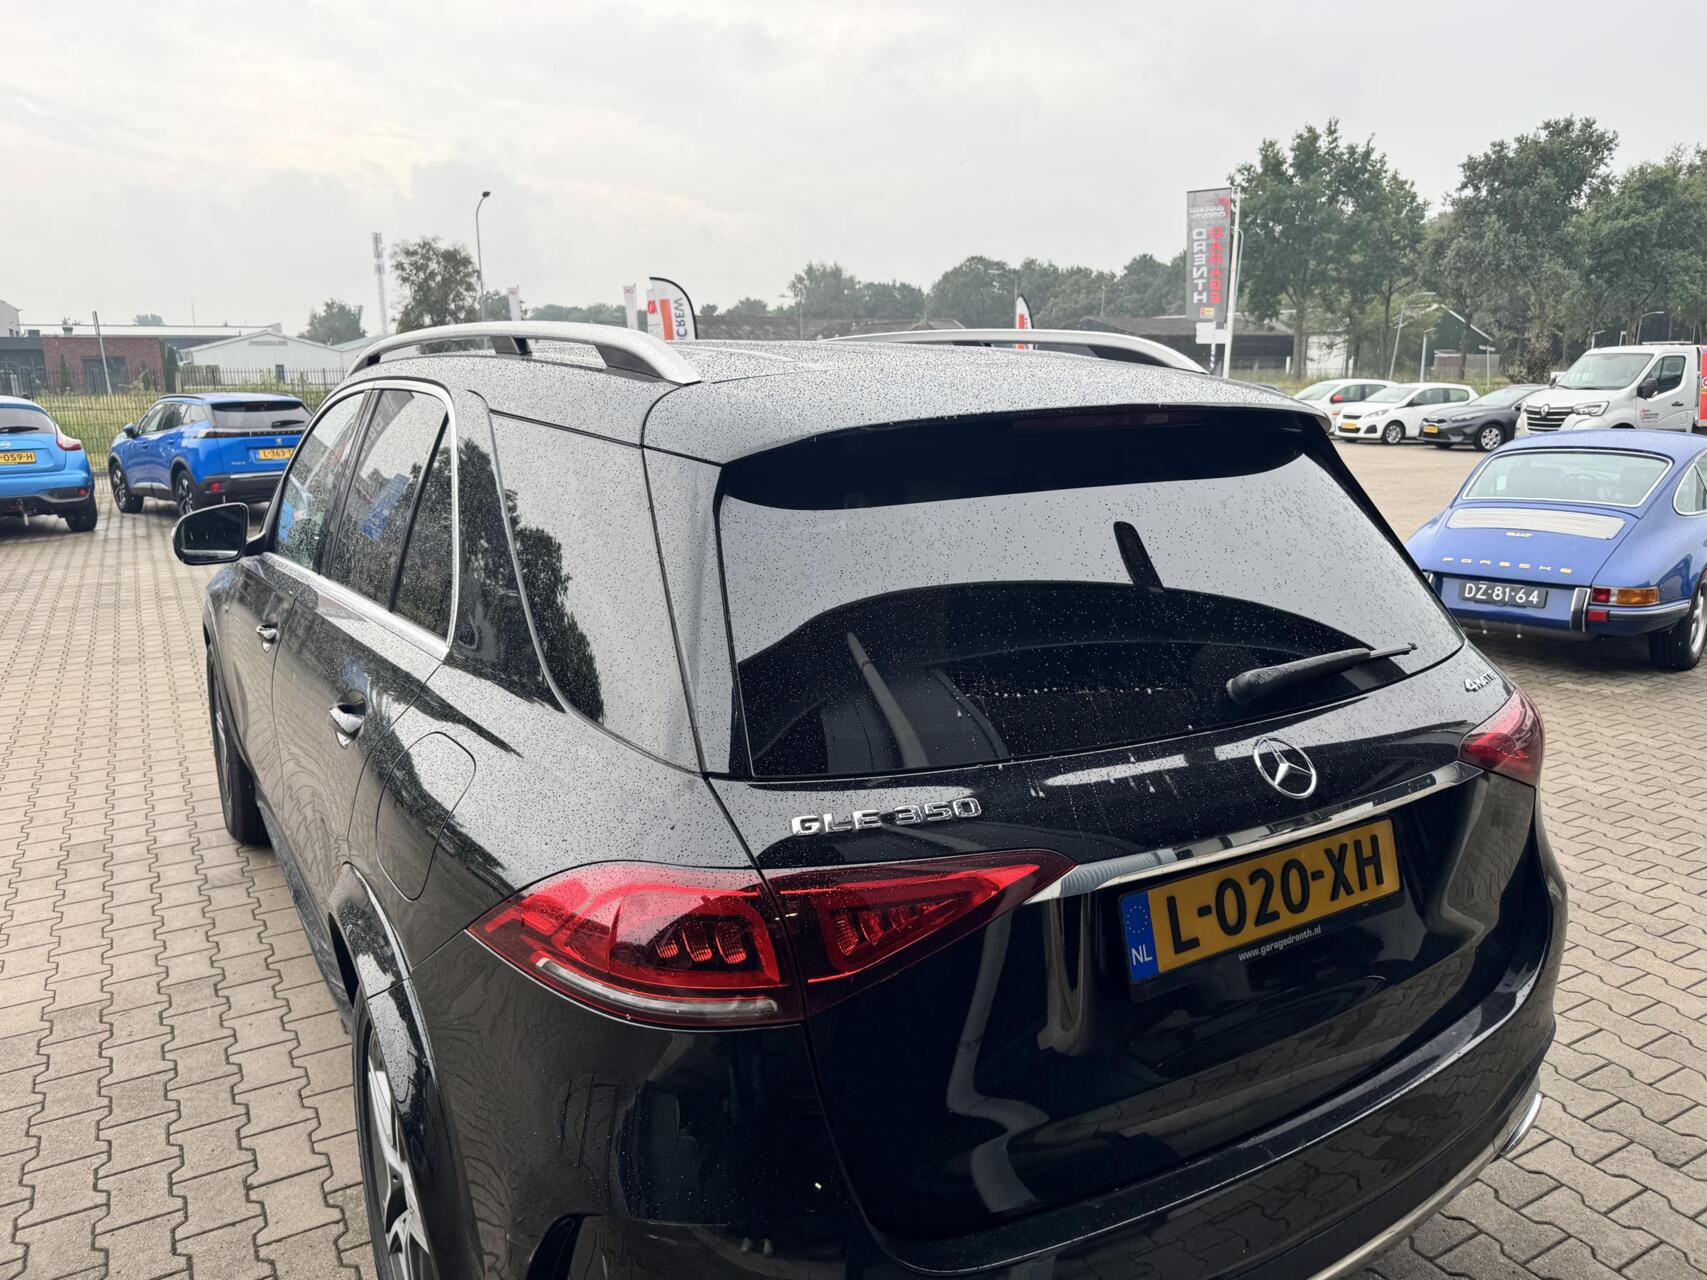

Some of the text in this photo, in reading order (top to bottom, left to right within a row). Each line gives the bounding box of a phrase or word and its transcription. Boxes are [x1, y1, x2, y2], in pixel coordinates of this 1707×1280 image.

[1442, 556, 1573, 574] PORSCHE
[1464, 583, 1539, 604] DZ-81-64
[791, 797, 982, 837] GLE 350
[1165, 834, 1385, 956] L-020-XH
[1131, 944, 1153, 966] NL
[1238, 925, 1322, 962] www.garagedrenth.nl
